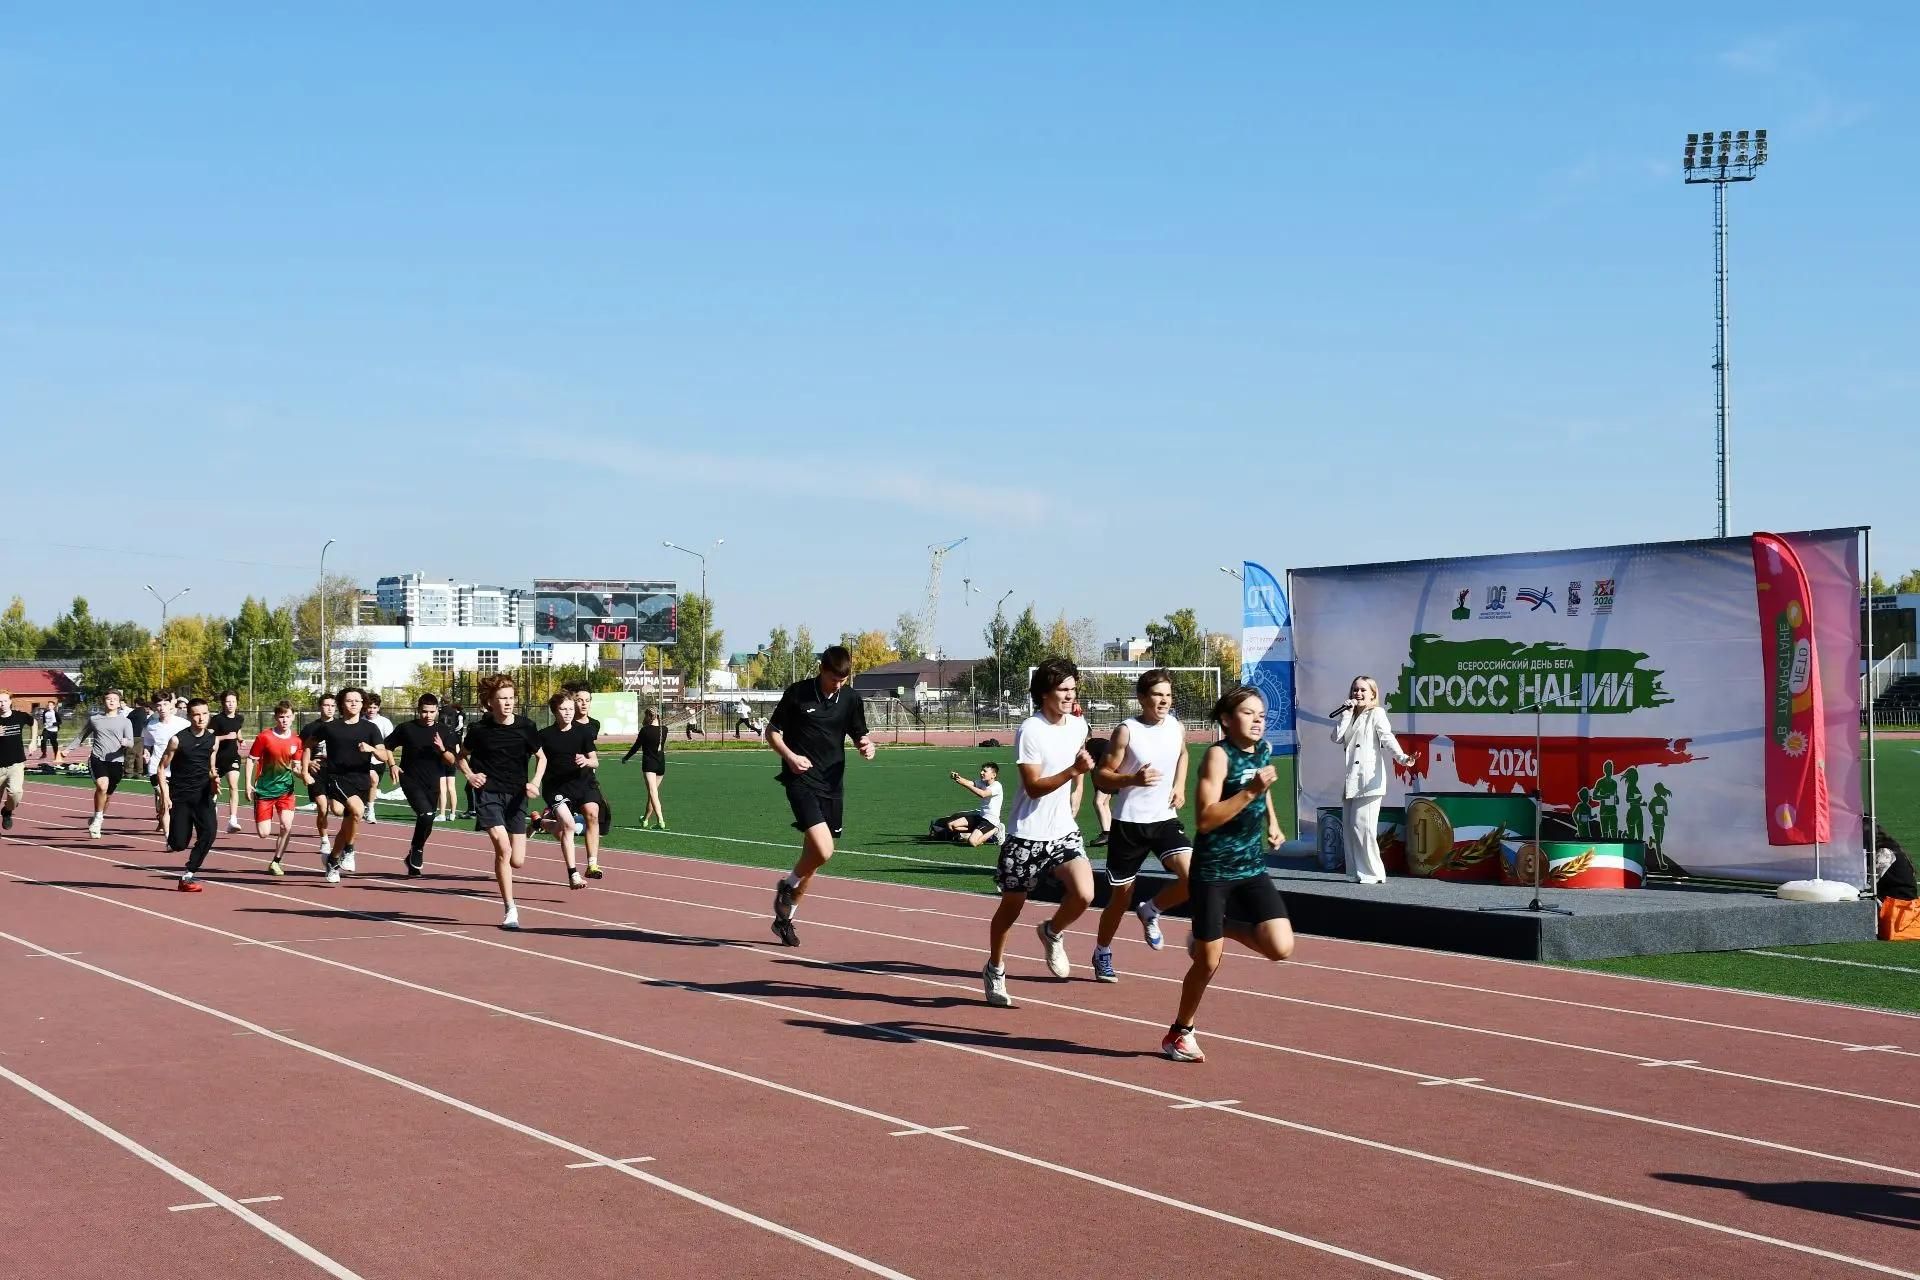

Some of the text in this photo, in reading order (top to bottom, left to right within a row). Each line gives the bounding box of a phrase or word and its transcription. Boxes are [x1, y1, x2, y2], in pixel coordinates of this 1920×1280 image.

[1594, 597, 1613, 605] 2026
[1458, 659, 1574, 671] ВСЕРОССИЙСКИЙ ДЕНЬ БЕГА
[1410, 672, 1634, 713] КРОСС НАЦИИ
[1488, 748, 1538, 777] 2026
[1323, 827, 1337, 854] 2
[1413, 818, 1427, 854] 1
[1526, 854, 1536, 873] 3
